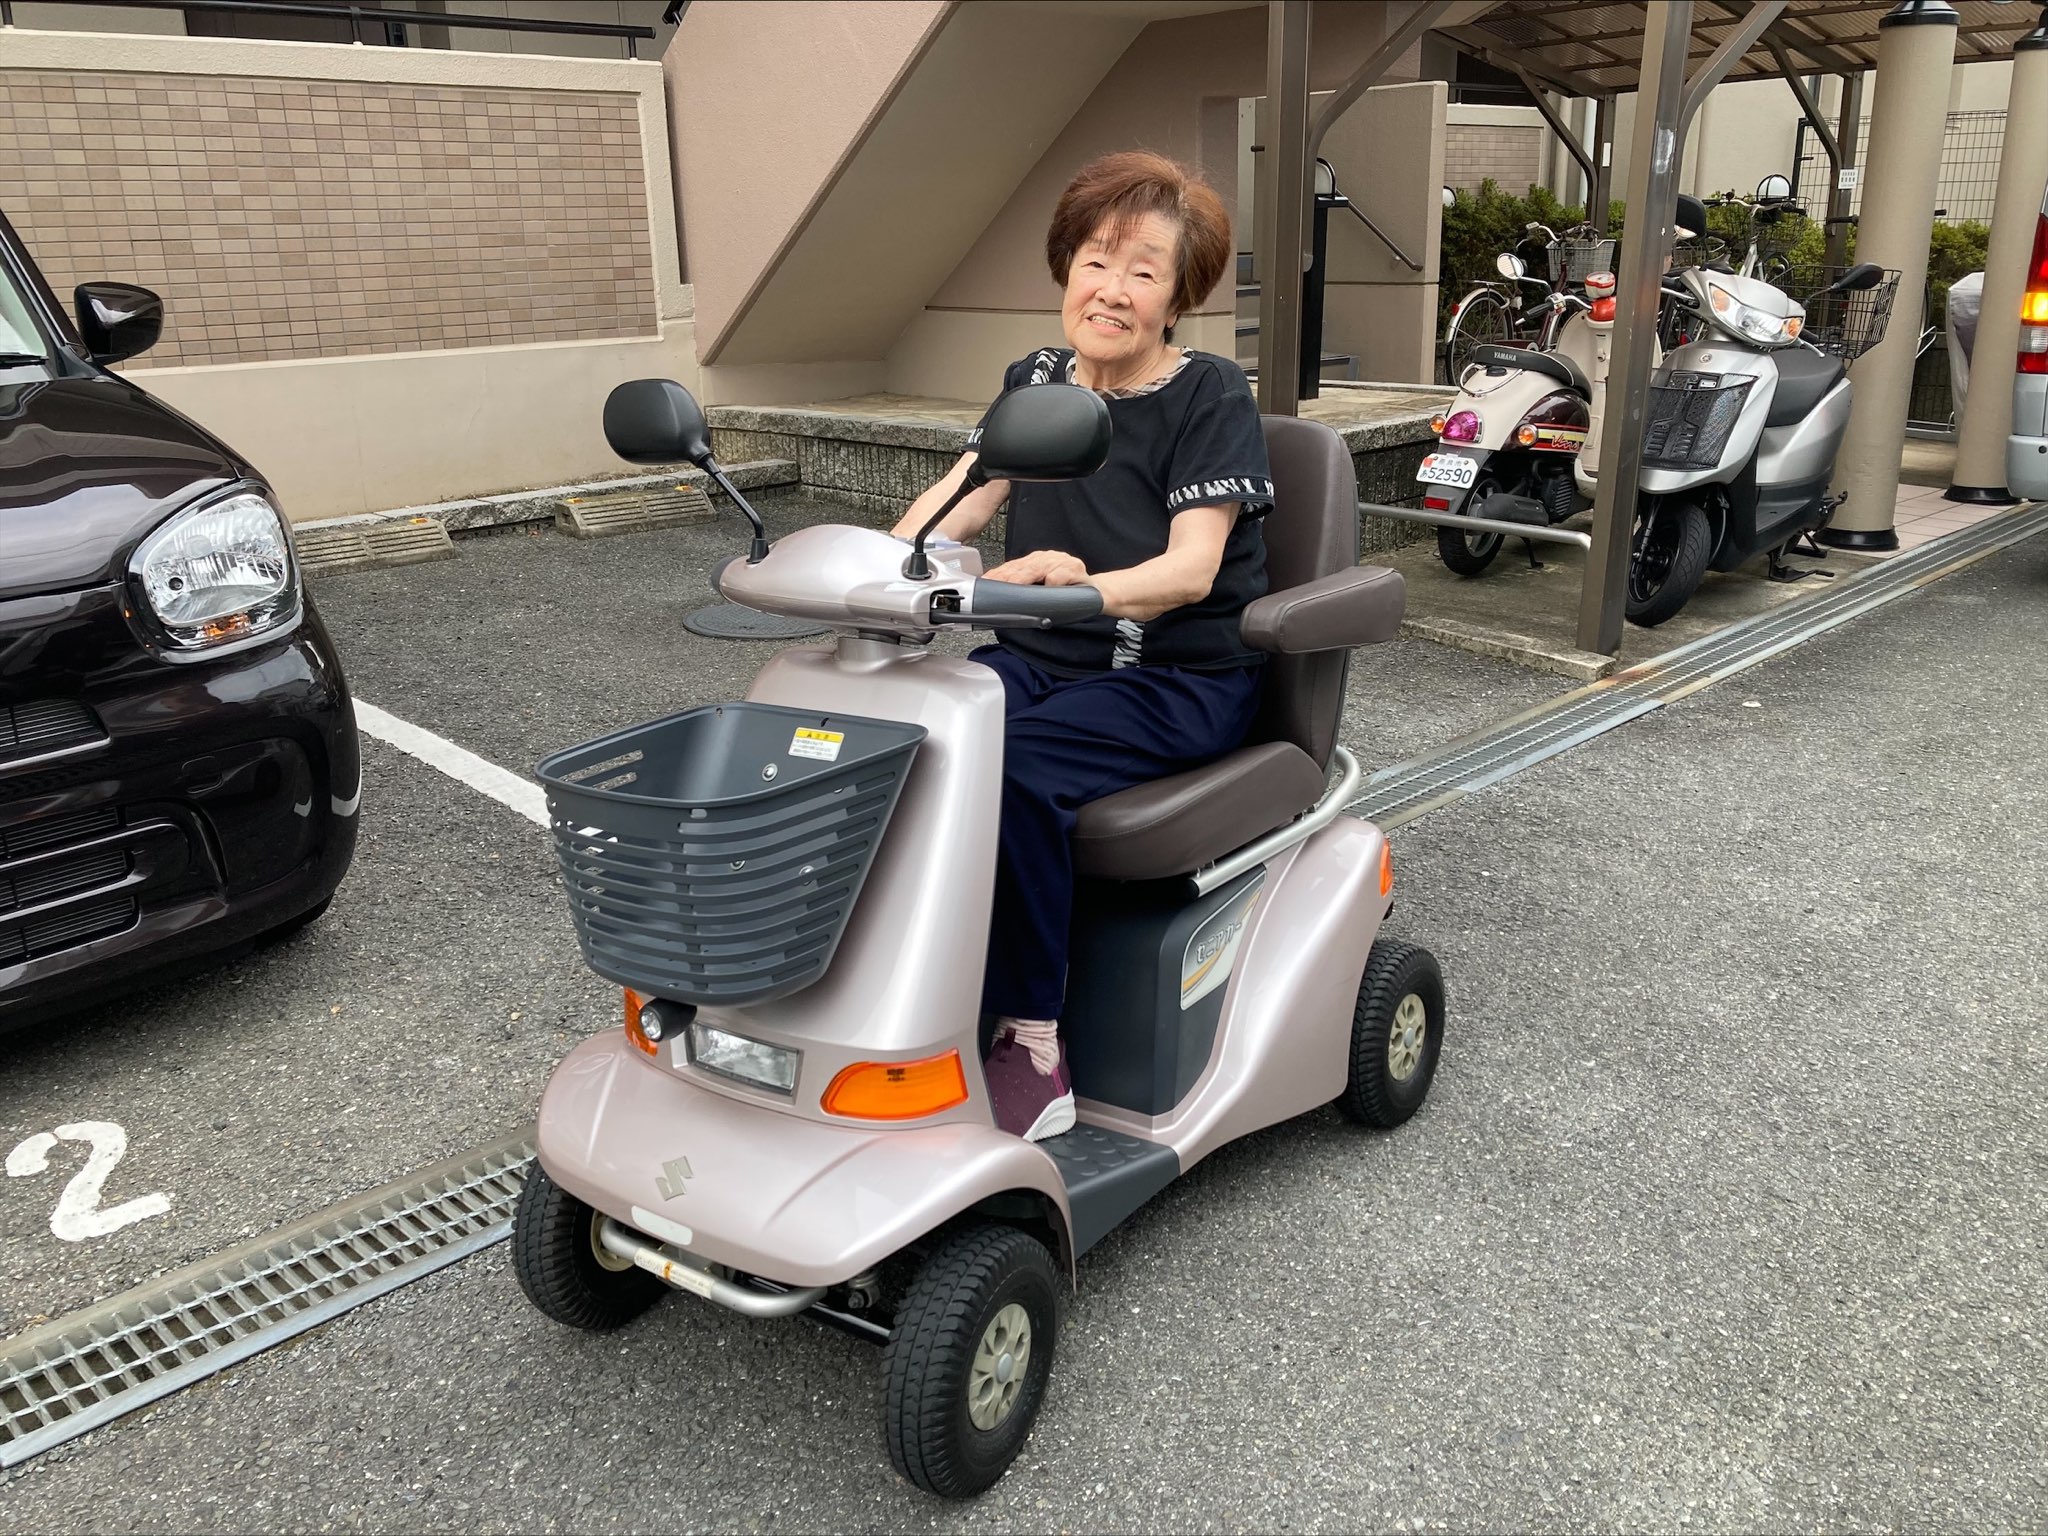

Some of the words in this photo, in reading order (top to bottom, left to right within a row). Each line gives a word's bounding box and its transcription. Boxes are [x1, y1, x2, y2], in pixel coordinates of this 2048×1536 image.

[1494, 351, 1517, 362] YAMAHA
[1427, 466, 1473, 485] 52590
[1196, 921, 1243, 964] セニアカー
[5, 1120, 171, 1242] 2
